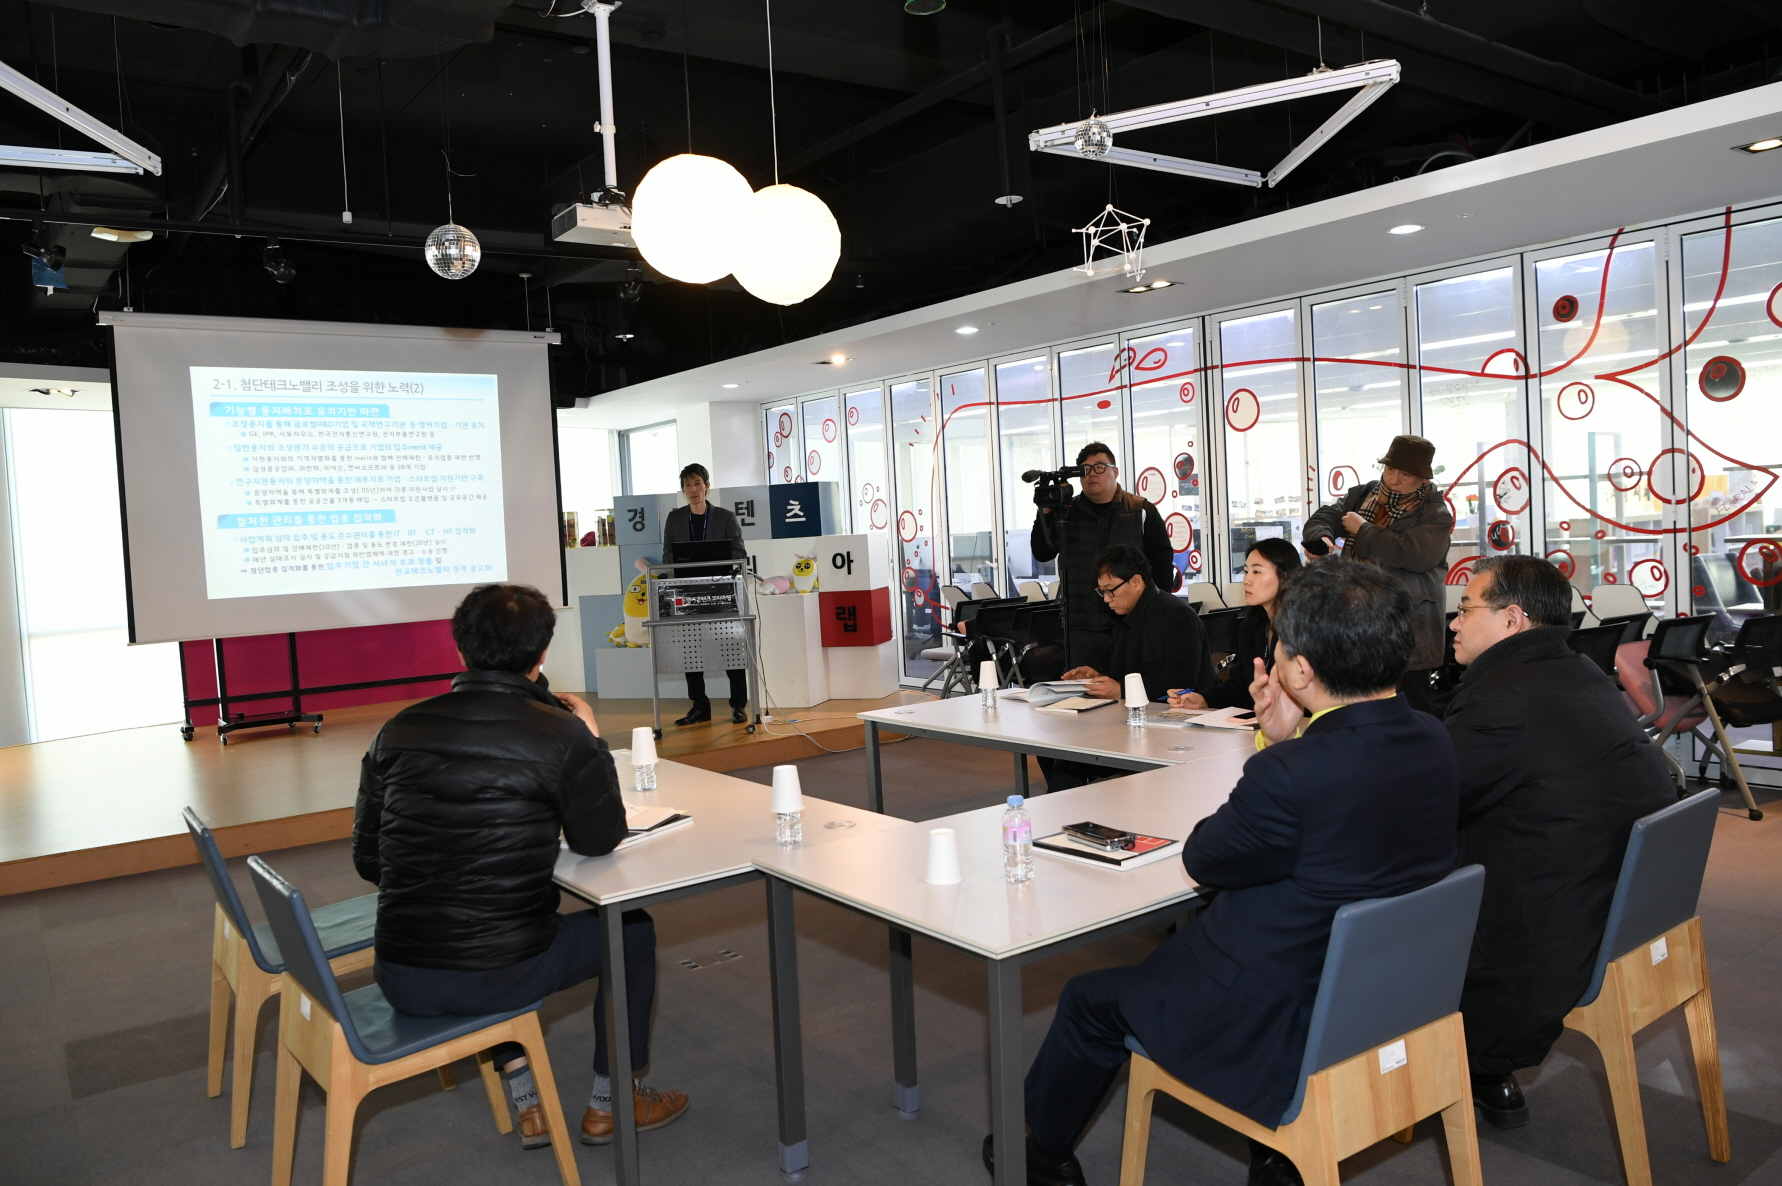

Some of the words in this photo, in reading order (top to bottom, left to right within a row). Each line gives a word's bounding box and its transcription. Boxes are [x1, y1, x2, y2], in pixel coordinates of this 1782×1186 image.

[213, 378, 236, 390] 2-1.
[240, 379, 322, 392] 첨단테크노밸리
[326, 380, 360, 393] 조성을
[363, 381, 385, 394] 위한
[388, 382, 424, 394] 노력(2)
[225, 406, 256, 416] 기능별
[261, 406, 313, 416] 용지배치로
[316, 406, 356, 417] 유치기반
[360, 407, 380, 417] 마련
[236, 516, 268, 528] 철저한
[272, 515, 303, 526] 관리를
[308, 515, 326, 525] 통한
[330, 514, 350, 524] 업종
[353, 513, 382, 523] 집적화
[627, 507, 646, 532] 경
[734, 500, 756, 526] 텐
[785, 500, 806, 522] 츠
[832, 550, 854, 575] 아
[836, 606, 858, 632] 랩
